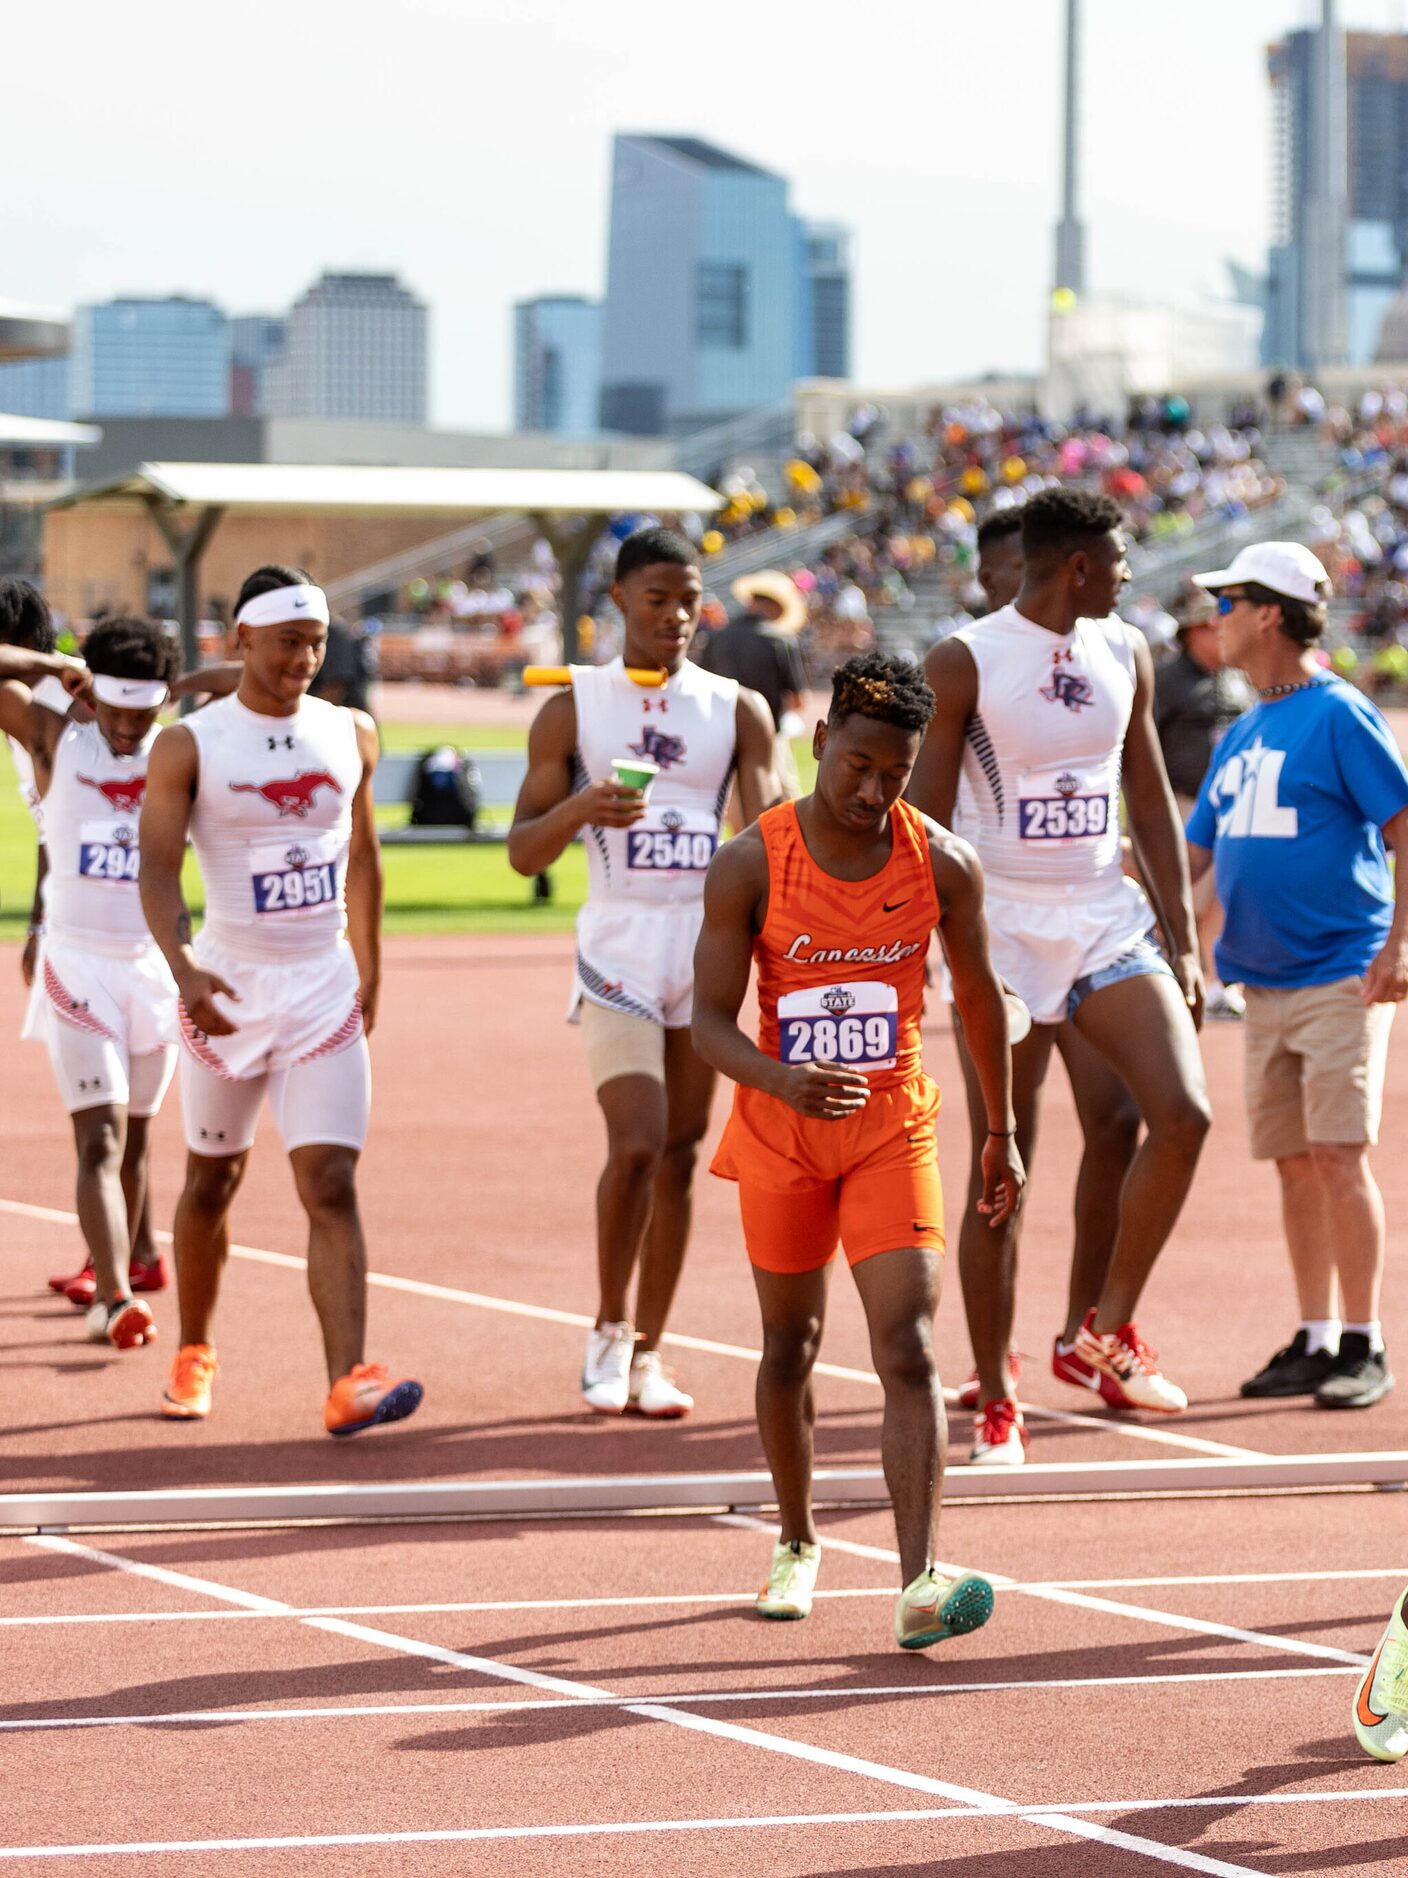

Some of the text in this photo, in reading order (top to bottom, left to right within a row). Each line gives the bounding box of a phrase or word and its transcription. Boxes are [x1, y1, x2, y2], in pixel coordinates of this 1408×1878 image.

[1024, 797, 1106, 838] 2539
[632, 832, 711, 868] 2540
[262, 864, 333, 910] 2951
[821, 996, 855, 1007] STATE
[788, 1016, 890, 1061] 2869
